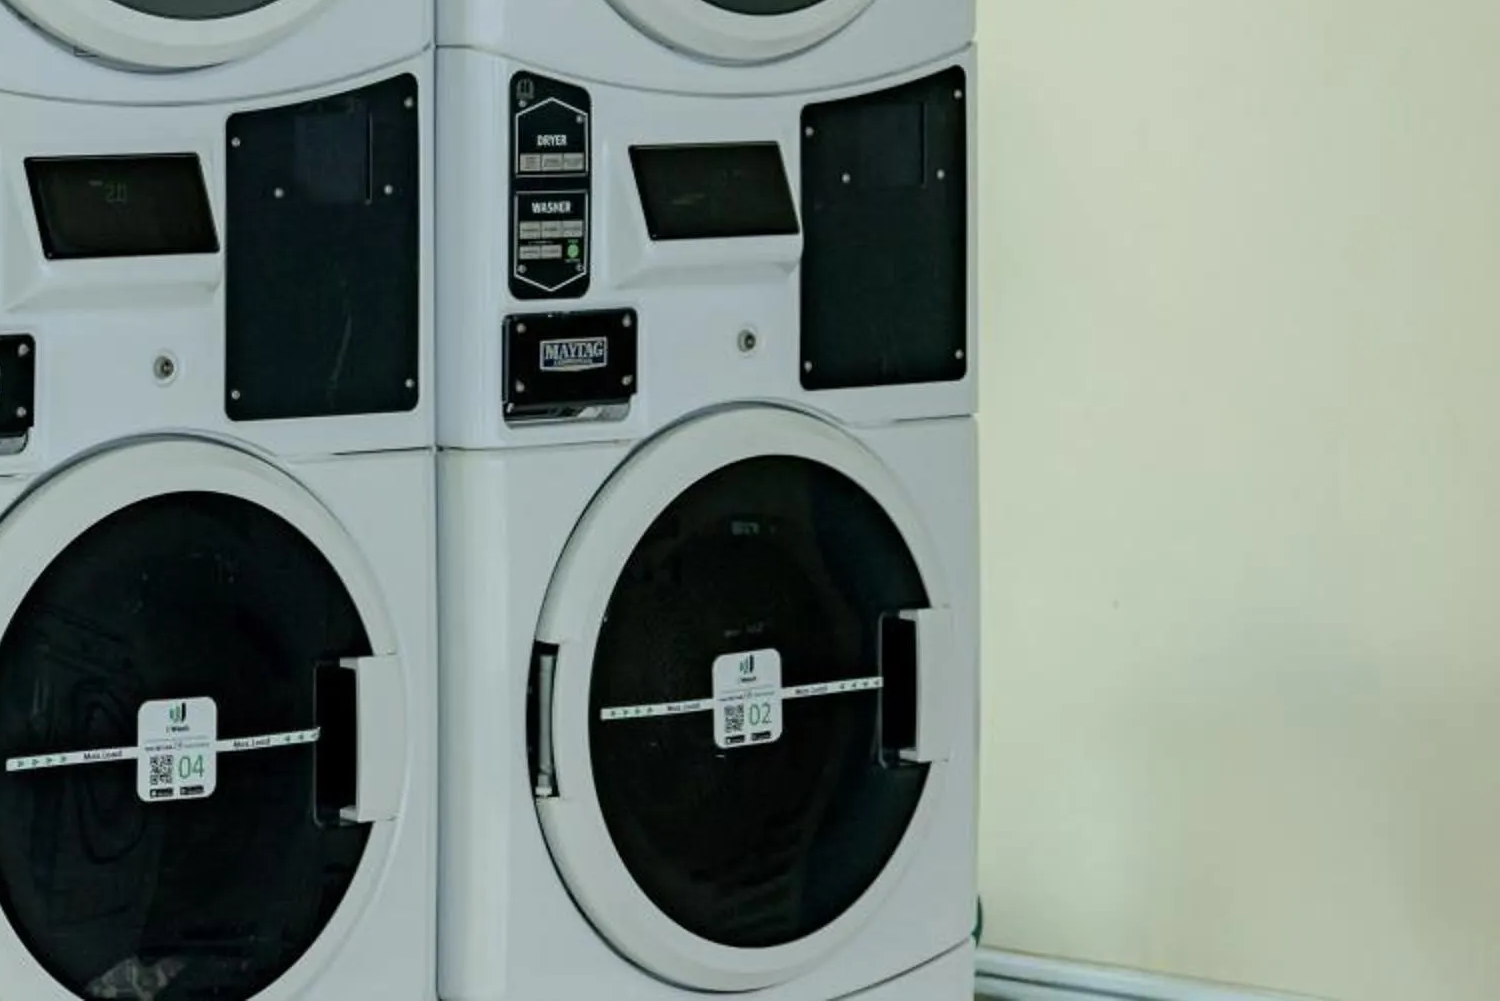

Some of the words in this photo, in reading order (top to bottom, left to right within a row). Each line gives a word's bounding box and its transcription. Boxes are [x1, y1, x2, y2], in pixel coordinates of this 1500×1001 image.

[536, 134, 567, 146] DRYER
[531, 201, 571, 214] WASHER
[545, 342, 603, 360] MAYTAG
[749, 702, 772, 726] 02
[179, 755, 204, 779] 04
